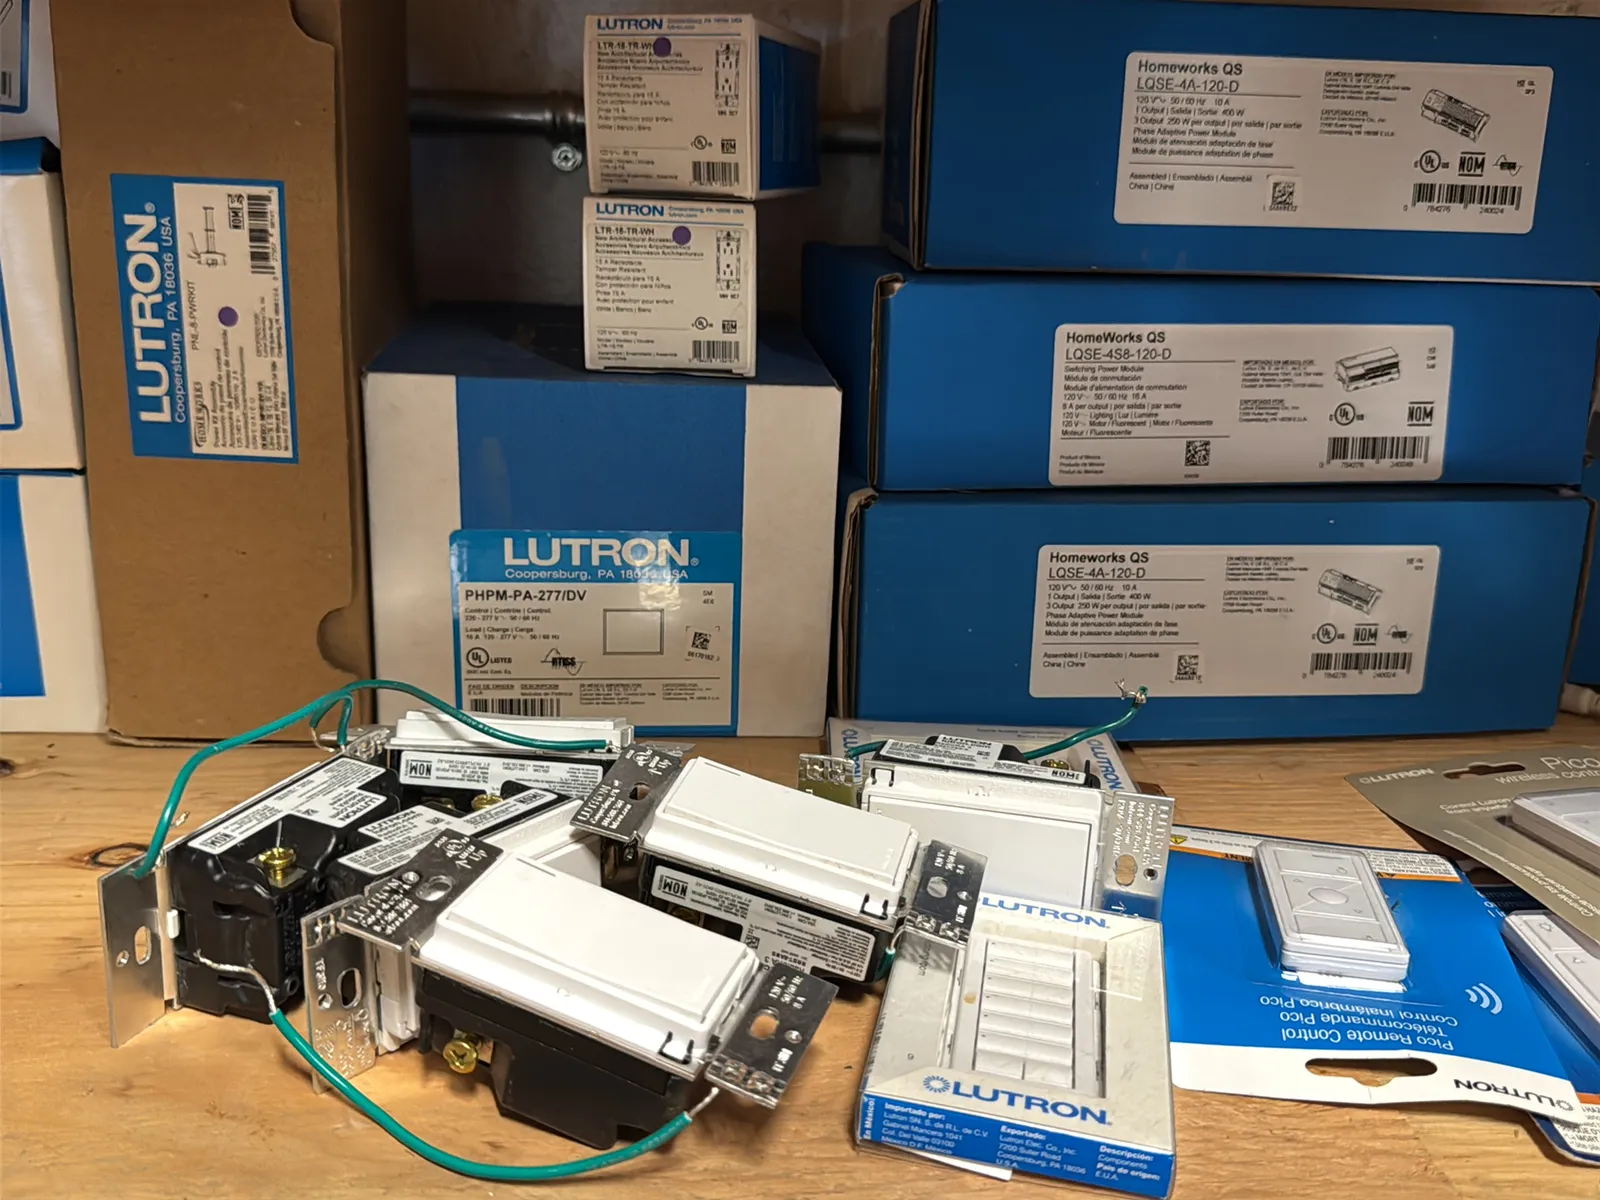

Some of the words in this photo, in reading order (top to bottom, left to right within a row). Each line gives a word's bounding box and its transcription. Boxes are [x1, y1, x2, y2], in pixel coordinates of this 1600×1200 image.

[597, 18, 663, 31] LUTRON
[1138, 60, 1218, 75] Homeworks
[1222, 63, 1243, 76] QS
[1136, 77, 1239, 92] LQSE-4A-120-D
[1157, 129, 1186, 137] Adaptive
[1188, 129, 1210, 137] Power
[1458, 156, 1486, 173] NOM
[1129, 172, 1167, 181] Assembled
[1173, 173, 1214, 182] Ensamblado
[1129, 182, 1148, 190] China
[596, 203, 664, 217] LUTRON
[161, 216, 173, 246] USA
[164, 253, 176, 296] 18036
[124, 212, 172, 423] LUTRON
[167, 301, 177, 322] PA
[188, 280, 198, 352] PNL-8-PWRKIT
[1066, 332, 1143, 343] HomeWorks
[1146, 332, 1166, 343] QS
[1065, 348, 1172, 360] LQSE-4S8-120-D
[168, 327, 186, 424] Coopersburg,
[1089, 412, 1113, 420] Lighting
[1407, 406, 1434, 422] NOM
[1062, 429, 1085, 437] Moteur
[503, 537, 690, 568] LUTRON
[1050, 552, 1126, 563] Homeworks
[1130, 552, 1149, 563] QS
[505, 568, 591, 580] Coopersburg,
[597, 569, 615, 579] PA
[662, 569, 688, 579] USA
[1048, 567, 1146, 578] LQSE-4A-120-D
[465, 590, 587, 601] PHPM-PA-277/DV
[1053, 593, 1075, 601] Output
[1052, 603, 1075, 611] Output
[1100, 603, 1111, 611] per
[1113, 602, 1133, 610] output
[1068, 612, 1096, 620] Adaptive
[1045, 629, 1069, 637] Module
[1080, 630, 1113, 638] puissance
[1114, 630, 1148, 638] adaptation
[1353, 628, 1378, 642] NOM
[1043, 651, 1078, 659] Assembled
[1042, 660, 1062, 668] China
[942, 736, 993, 747] LUTRON
[409, 761, 432, 776] NOM
[1093, 747, 1123, 791] LUTRON
[1540, 756, 1600, 770] Pico
[1051, 770, 1075, 779] NOM
[1369, 768, 1435, 783] LUTRON
[1494, 773, 1560, 785] Wireless
[339, 796, 381, 822] LUTRON
[577, 784, 611, 820] LUTRON
[470, 849, 488, 862] Up
[663, 878, 688, 897] NOM
[982, 897, 1107, 929] LUTRON
[1260, 995, 1295, 1009] Pico
[1300, 998, 1394, 1019] inalámbrico
[1279, 1011, 1315, 1025] Pico
[1320, 1013, 1448, 1038] Télécommande
[1400, 1011, 1458, 1027] Control
[1281, 1027, 1341, 1043] Control
[1346, 1029, 1412, 1045] Remote
[1416, 1035, 1455, 1051] Pico
[1453, 1079, 1556, 1108] LUTRON
[952, 1081, 1107, 1125] LUTRON
[884, 1102, 927, 1116] Importado
[928, 1112, 946, 1120] por:
[863, 1130, 872, 1139] En
[882, 1128, 895, 1136] Col.
[898, 1131, 911, 1139] Del
[912, 1134, 929, 1142] Valle
[883, 1120, 910, 1130] Gabriel
[911, 1125, 944, 1137] Mancera
[1000, 1125, 1046, 1140] Exportado:
[999, 1135, 1024, 1145] Lutron
[998, 1143, 1018, 1152] 7200
[1040, 1151, 1062, 1161] Road
[1100, 1145, 1154, 1162] Descripción:
[1049, 1161, 1061, 1169] PA
[1117, 1166, 1128, 1174] de
[1129, 1169, 1161, 1181] origen:
